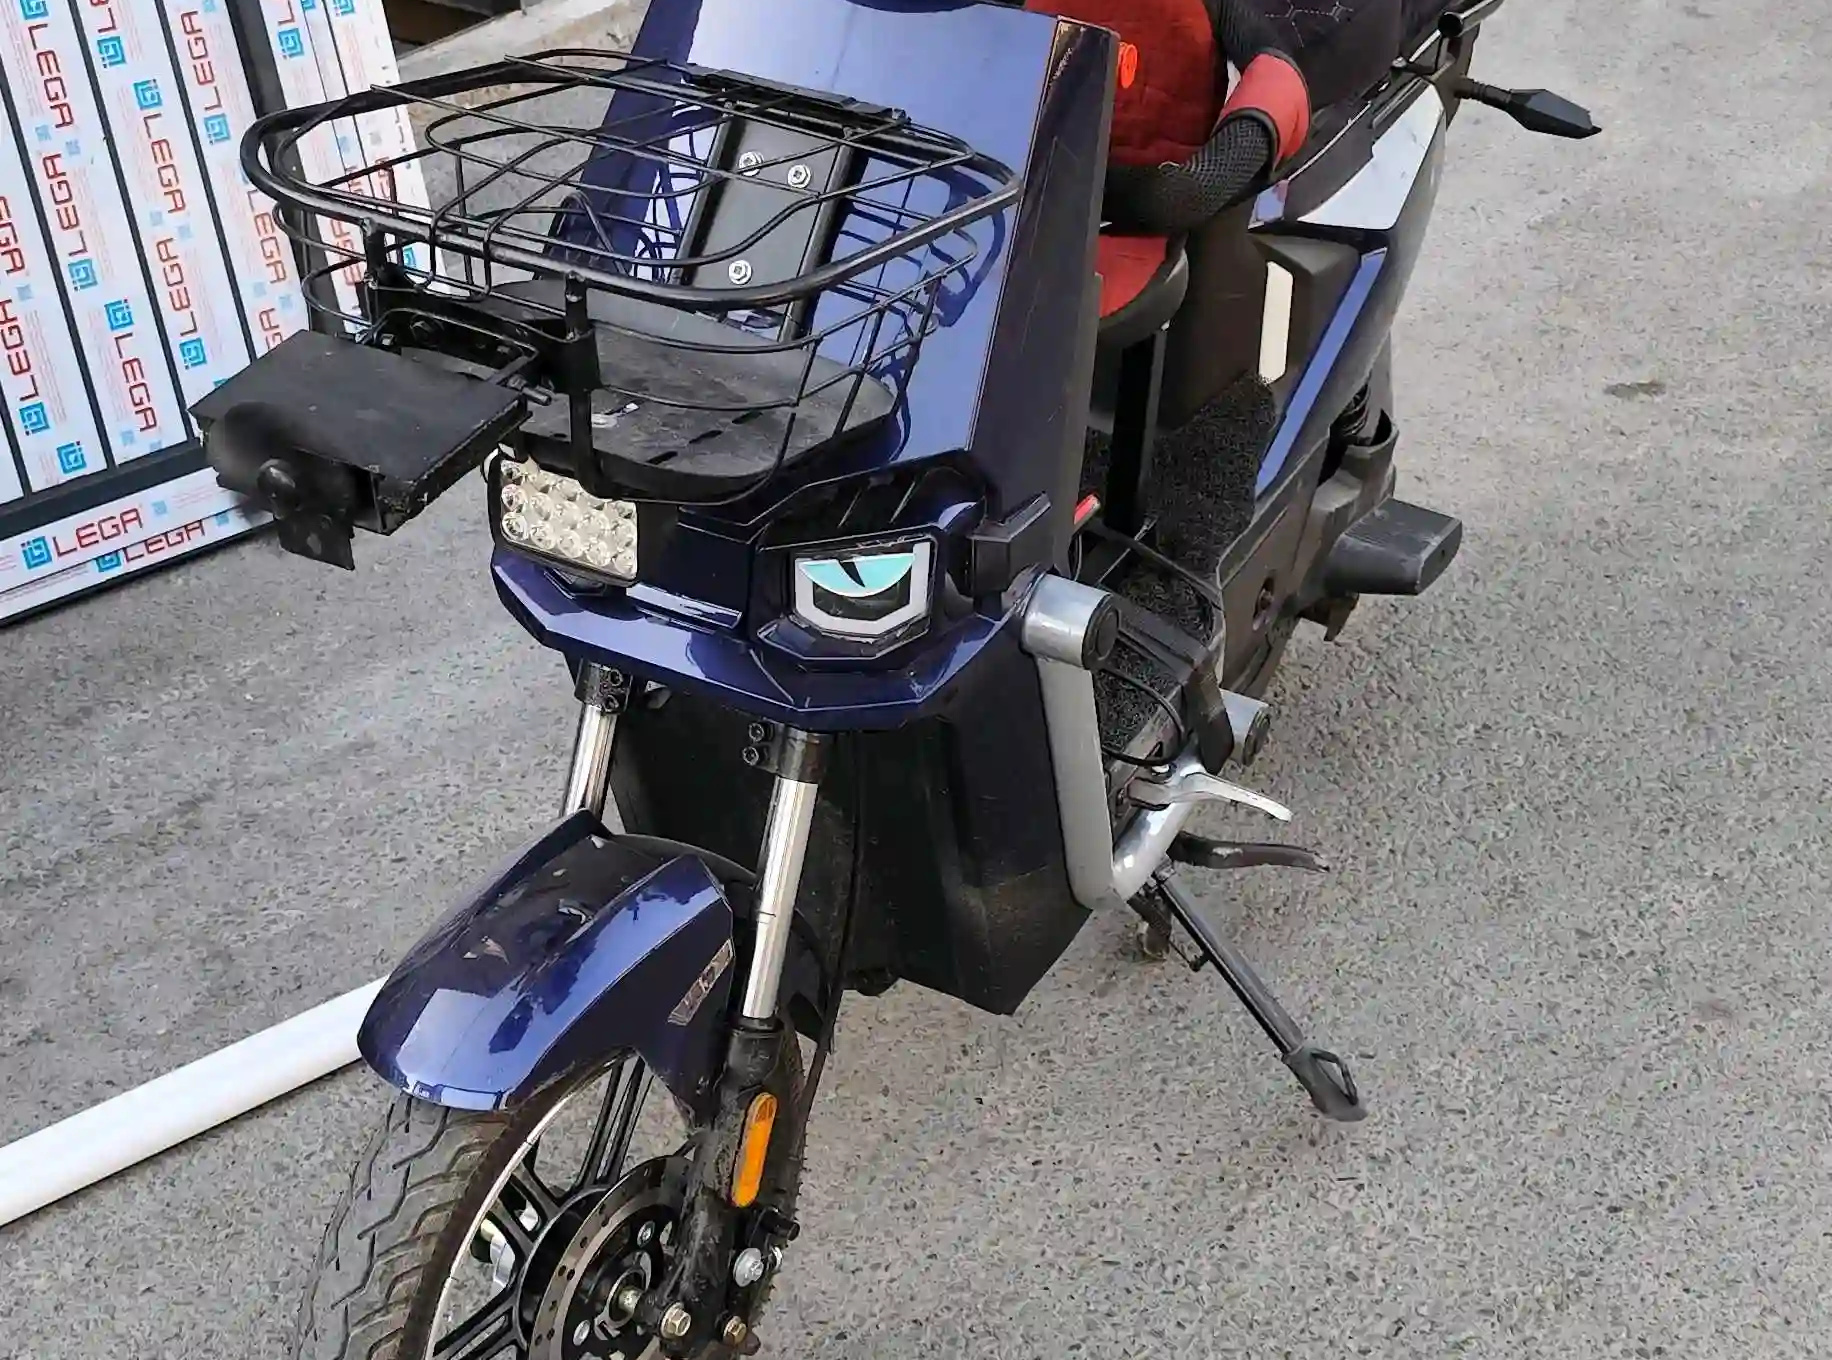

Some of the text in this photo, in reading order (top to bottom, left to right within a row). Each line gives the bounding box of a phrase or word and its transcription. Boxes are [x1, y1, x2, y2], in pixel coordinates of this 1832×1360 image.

[28, 24, 74, 128] LEGA
[181, 11, 224, 111] LEGA
[43, 153, 87, 257] LEGA
[144, 113, 186, 213] LEGA
[247, 189, 287, 284] LEGA
[156, 238, 200, 337] LEGA
[0, 299, 39, 401] LEGA
[113, 333, 157, 432] LEGA
[53, 508, 143, 557] LEGA
